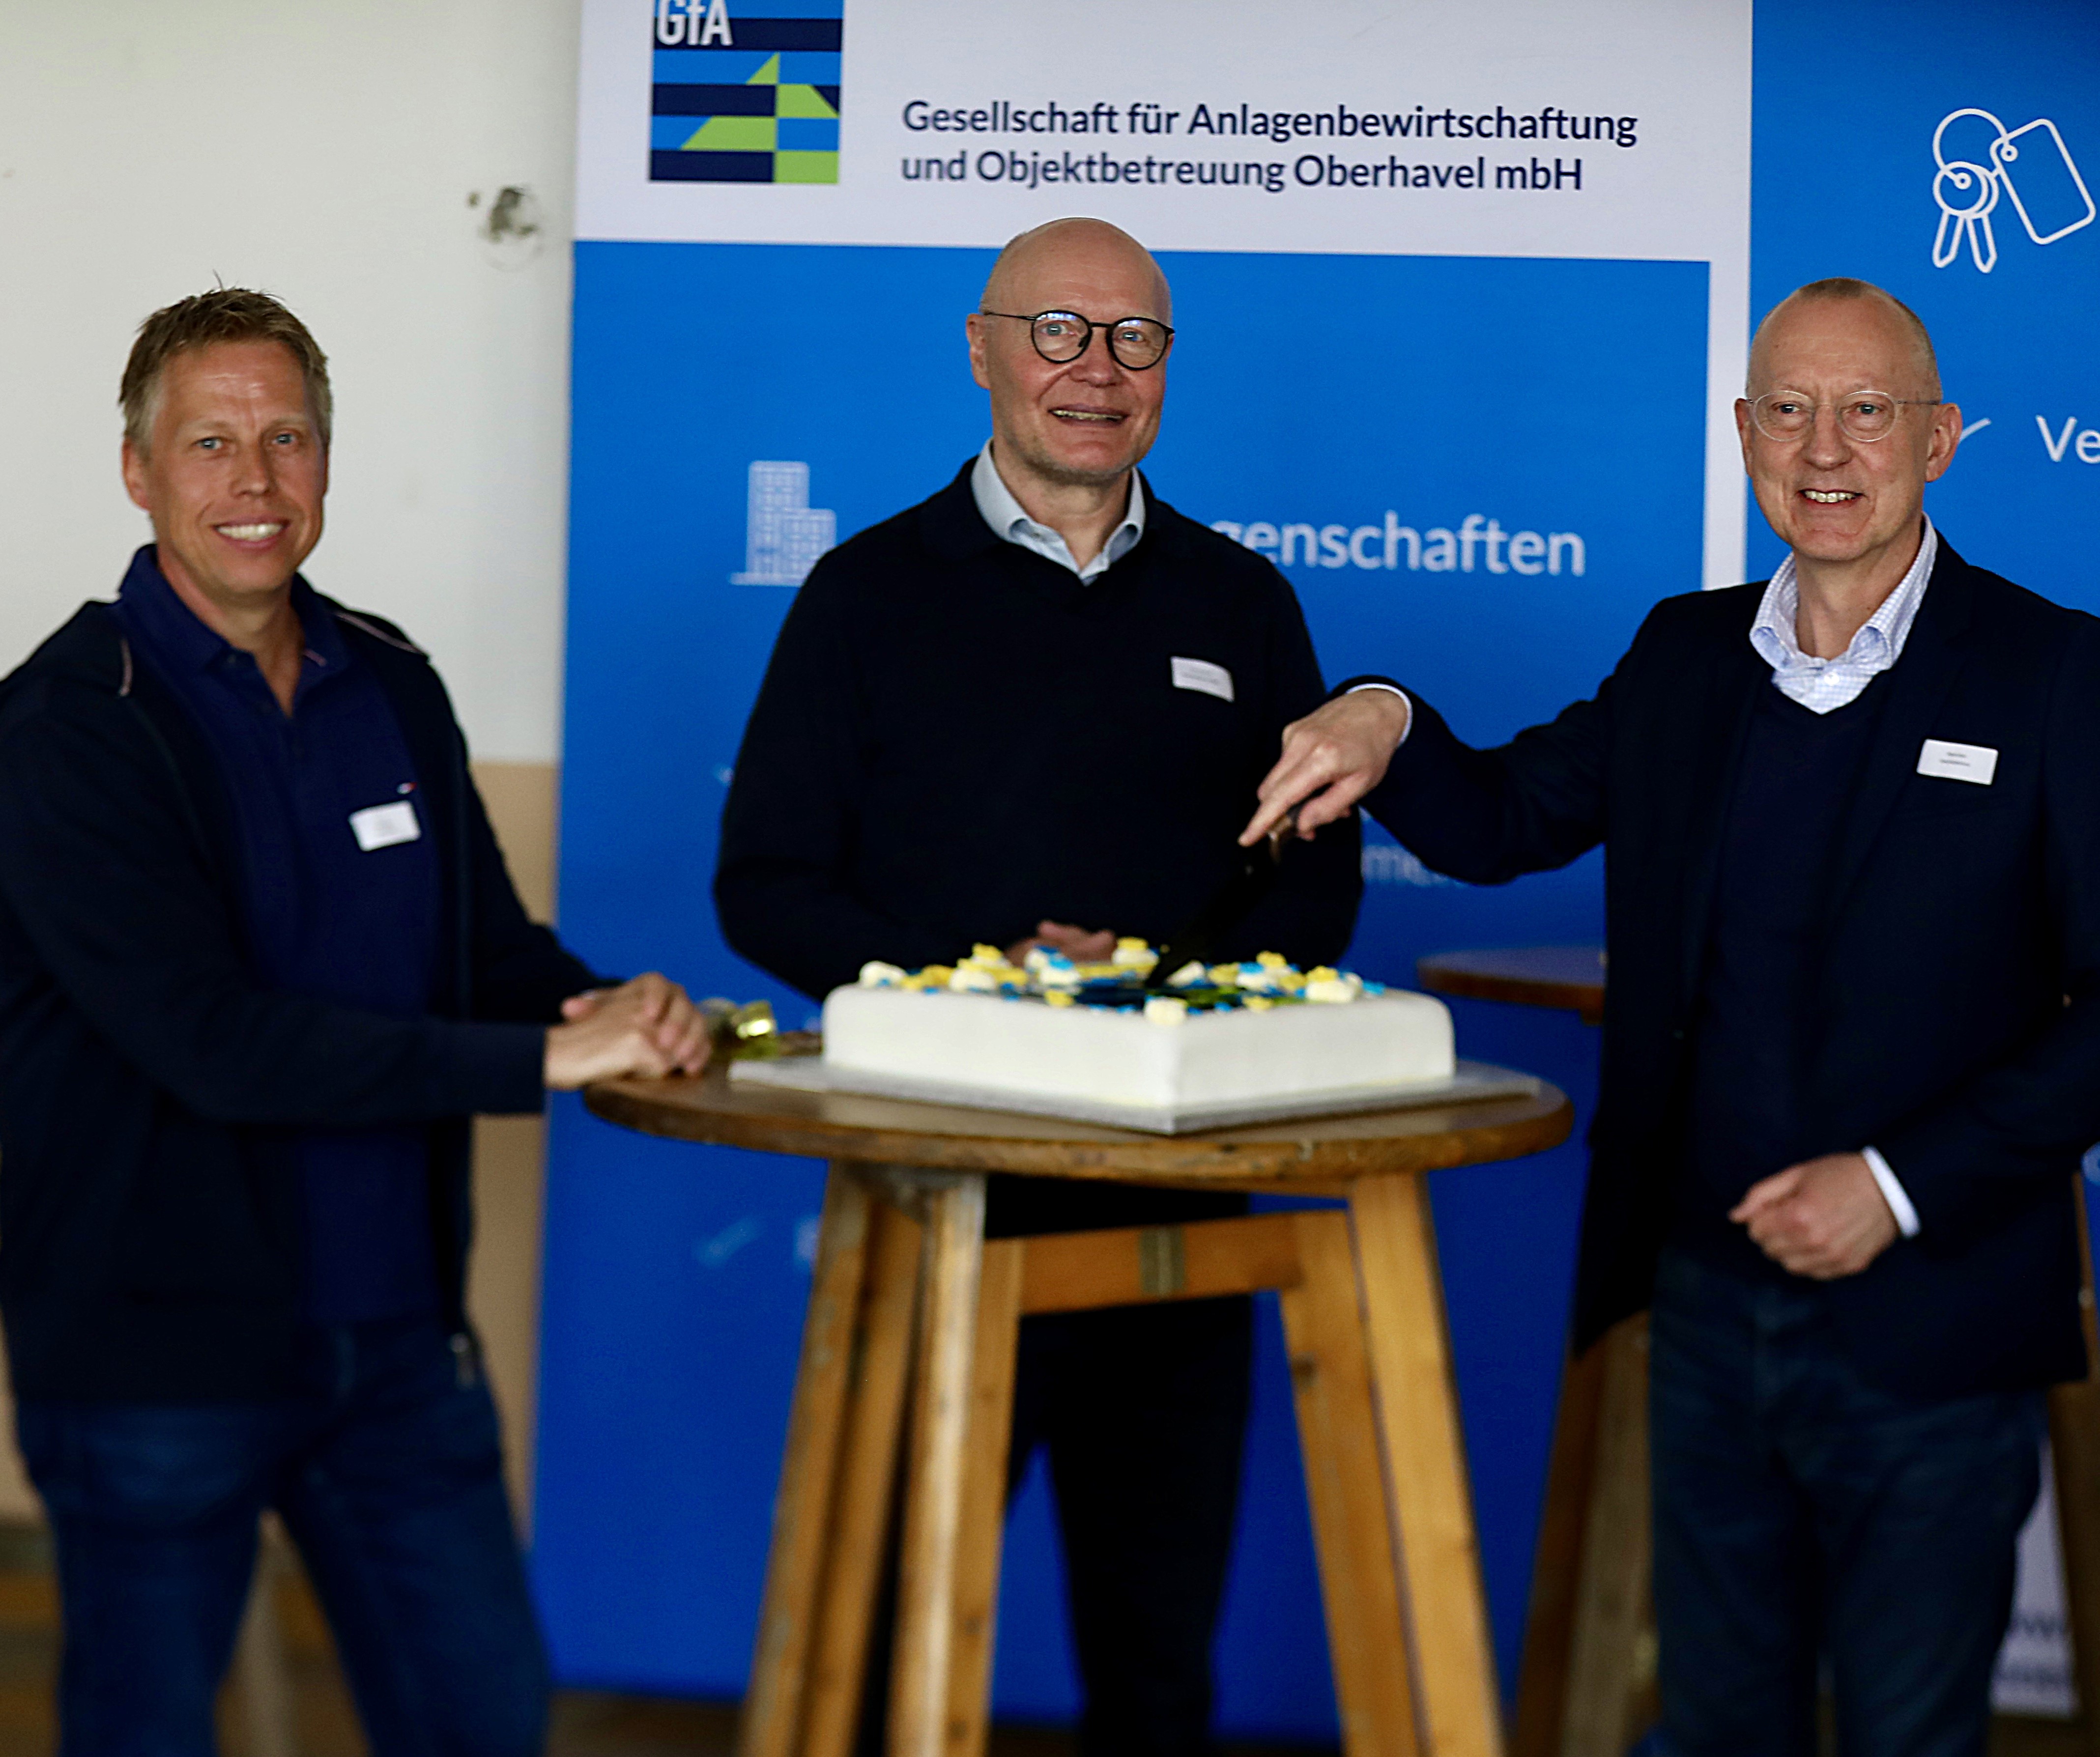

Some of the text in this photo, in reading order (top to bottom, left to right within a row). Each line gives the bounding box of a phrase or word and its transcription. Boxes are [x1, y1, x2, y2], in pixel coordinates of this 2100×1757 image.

[657, 0, 733, 46] GfA
[902, 100, 1639, 148] Gesellschaft für Anlagenbewirtschaftung
[901, 150, 1582, 194] und Objektbetreuung Oberhavel mbH
[2036, 415, 2100, 463] Ve
